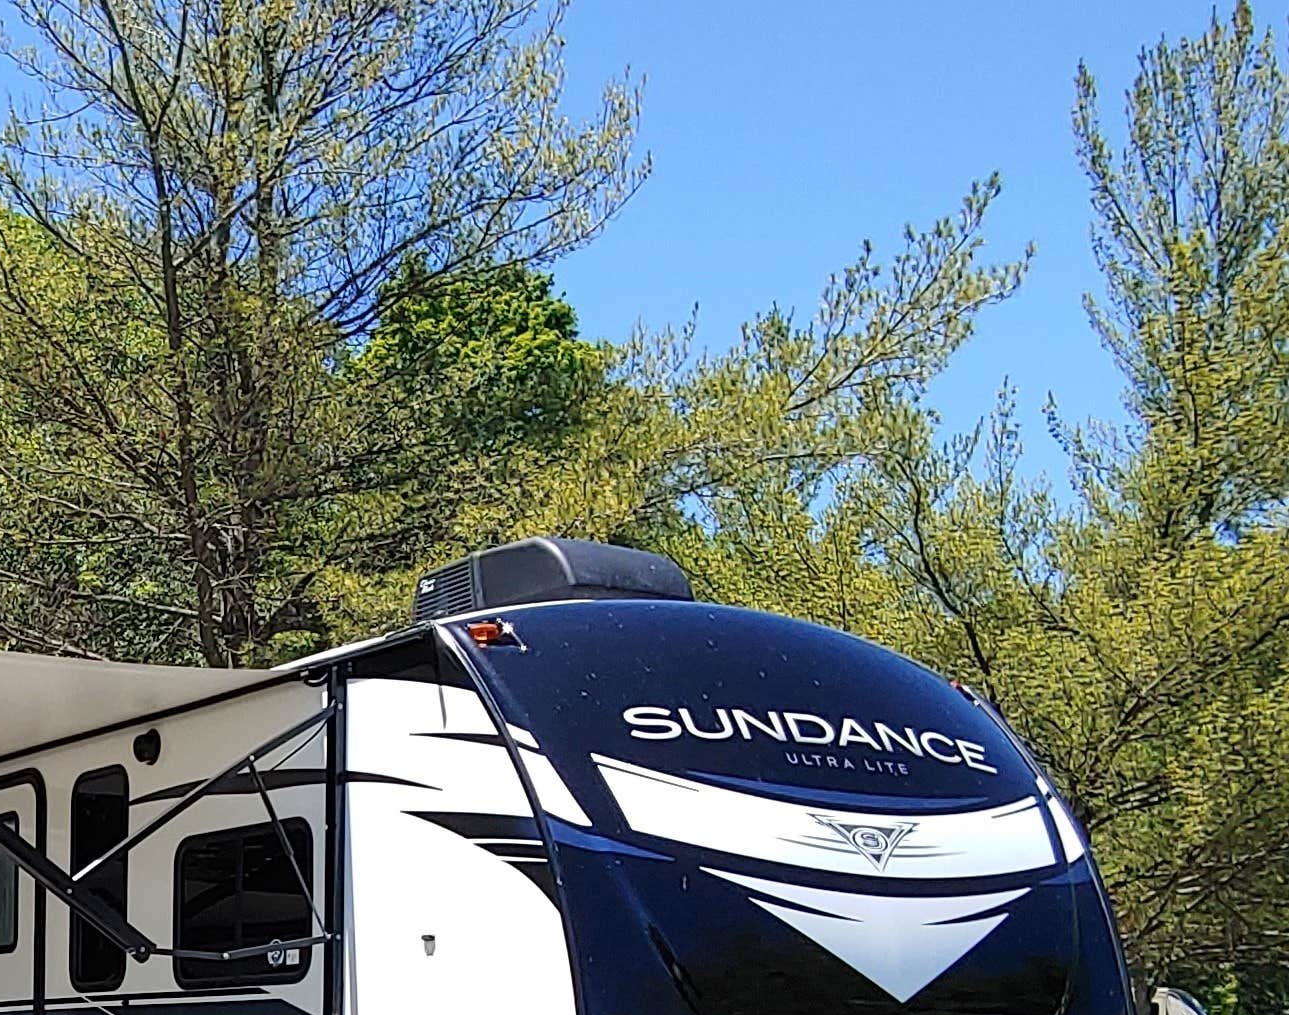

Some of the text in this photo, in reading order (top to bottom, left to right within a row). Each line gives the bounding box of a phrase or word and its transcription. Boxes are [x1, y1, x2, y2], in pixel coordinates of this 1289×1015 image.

[622, 706, 998, 774] SUNDANCE
[785, 752, 909, 775] ULTRA LITE
